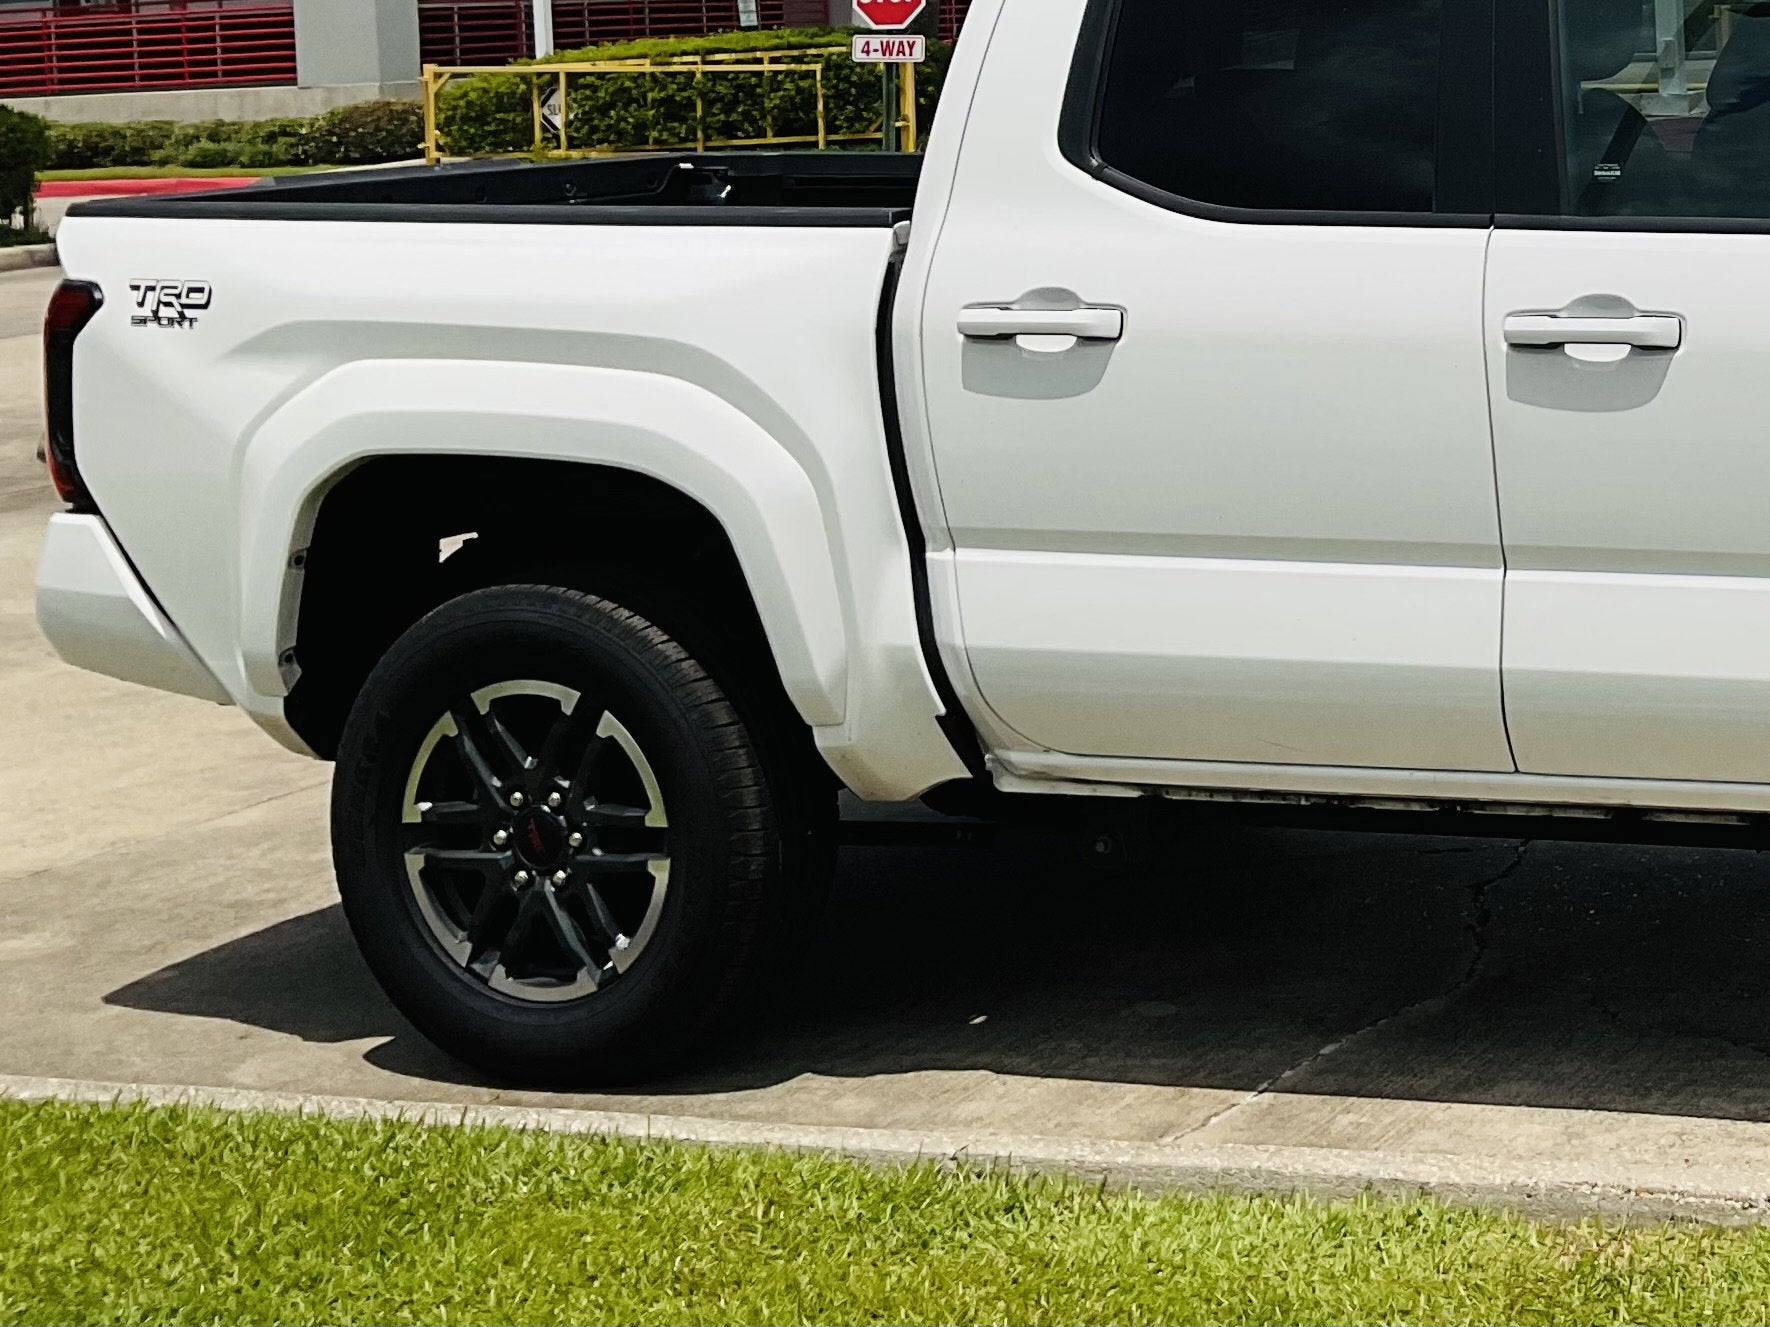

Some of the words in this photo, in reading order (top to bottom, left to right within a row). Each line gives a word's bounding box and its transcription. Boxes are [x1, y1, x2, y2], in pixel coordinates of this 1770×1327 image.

[861, 40, 916, 57] 4-WAY
[129, 278, 212, 319] TRD
[131, 315, 198, 329] SPORT
